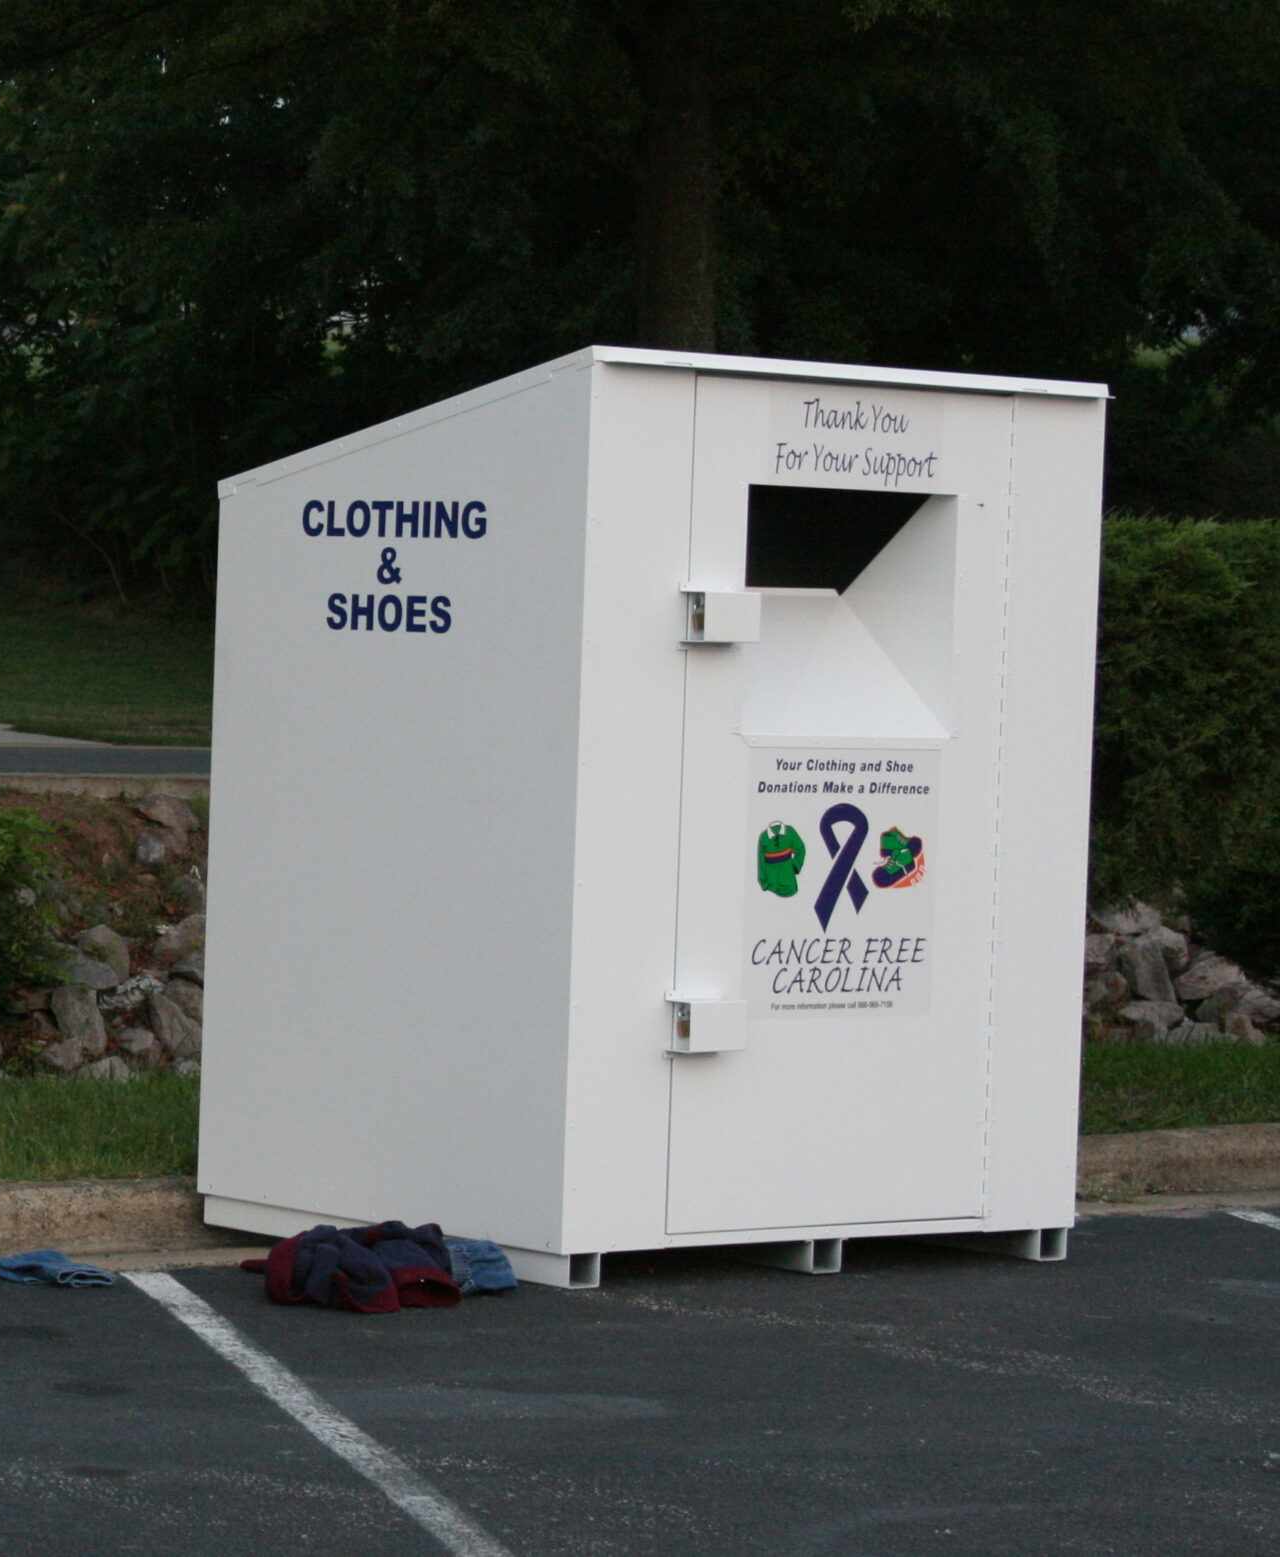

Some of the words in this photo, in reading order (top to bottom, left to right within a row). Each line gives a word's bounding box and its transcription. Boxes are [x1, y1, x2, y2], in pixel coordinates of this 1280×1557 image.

[803, 398, 869, 431] Thank
[872, 404, 910, 434] You
[775, 442, 809, 474] For
[813, 442, 859, 474] Your
[862, 447, 938, 488] Support
[302, 499, 487, 539] CLOTHING
[376, 546, 402, 585] &
[326, 592, 452, 634] SHOES
[776, 758, 802, 771] Your
[806, 758, 856, 774] Clothing
[860, 760, 882, 773] and
[885, 760, 914, 773] Shoe
[757, 781, 818, 793] Donations
[822, 781, 854, 794] Make
[858, 784, 865, 793] a
[869, 782, 930, 795] Difference
[751, 936, 853, 966] CANCER
[862, 936, 927, 965] FREE
[772, 966, 903, 994] CAROLINA
[797, 1002, 827, 1010] information
